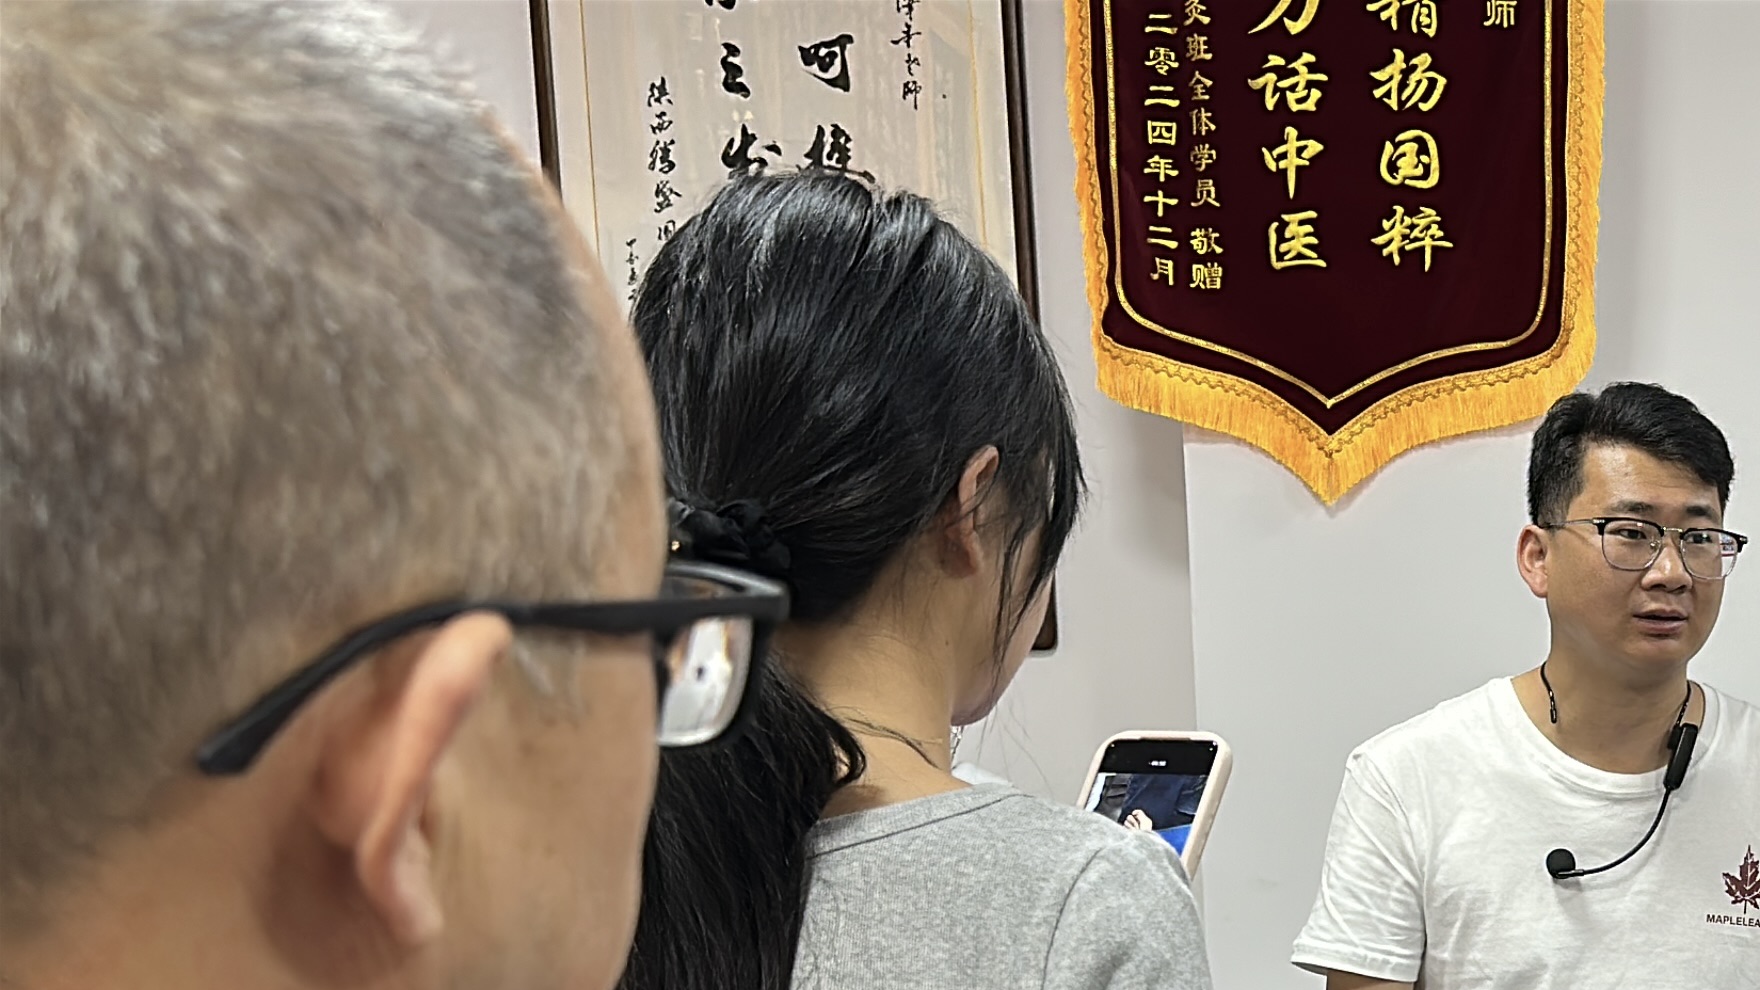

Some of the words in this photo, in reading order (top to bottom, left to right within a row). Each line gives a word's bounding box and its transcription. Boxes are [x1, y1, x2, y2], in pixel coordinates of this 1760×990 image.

[1143, 13, 1180, 288] 二零二四年十二月
[1189, 226, 1224, 291] 敬赠
